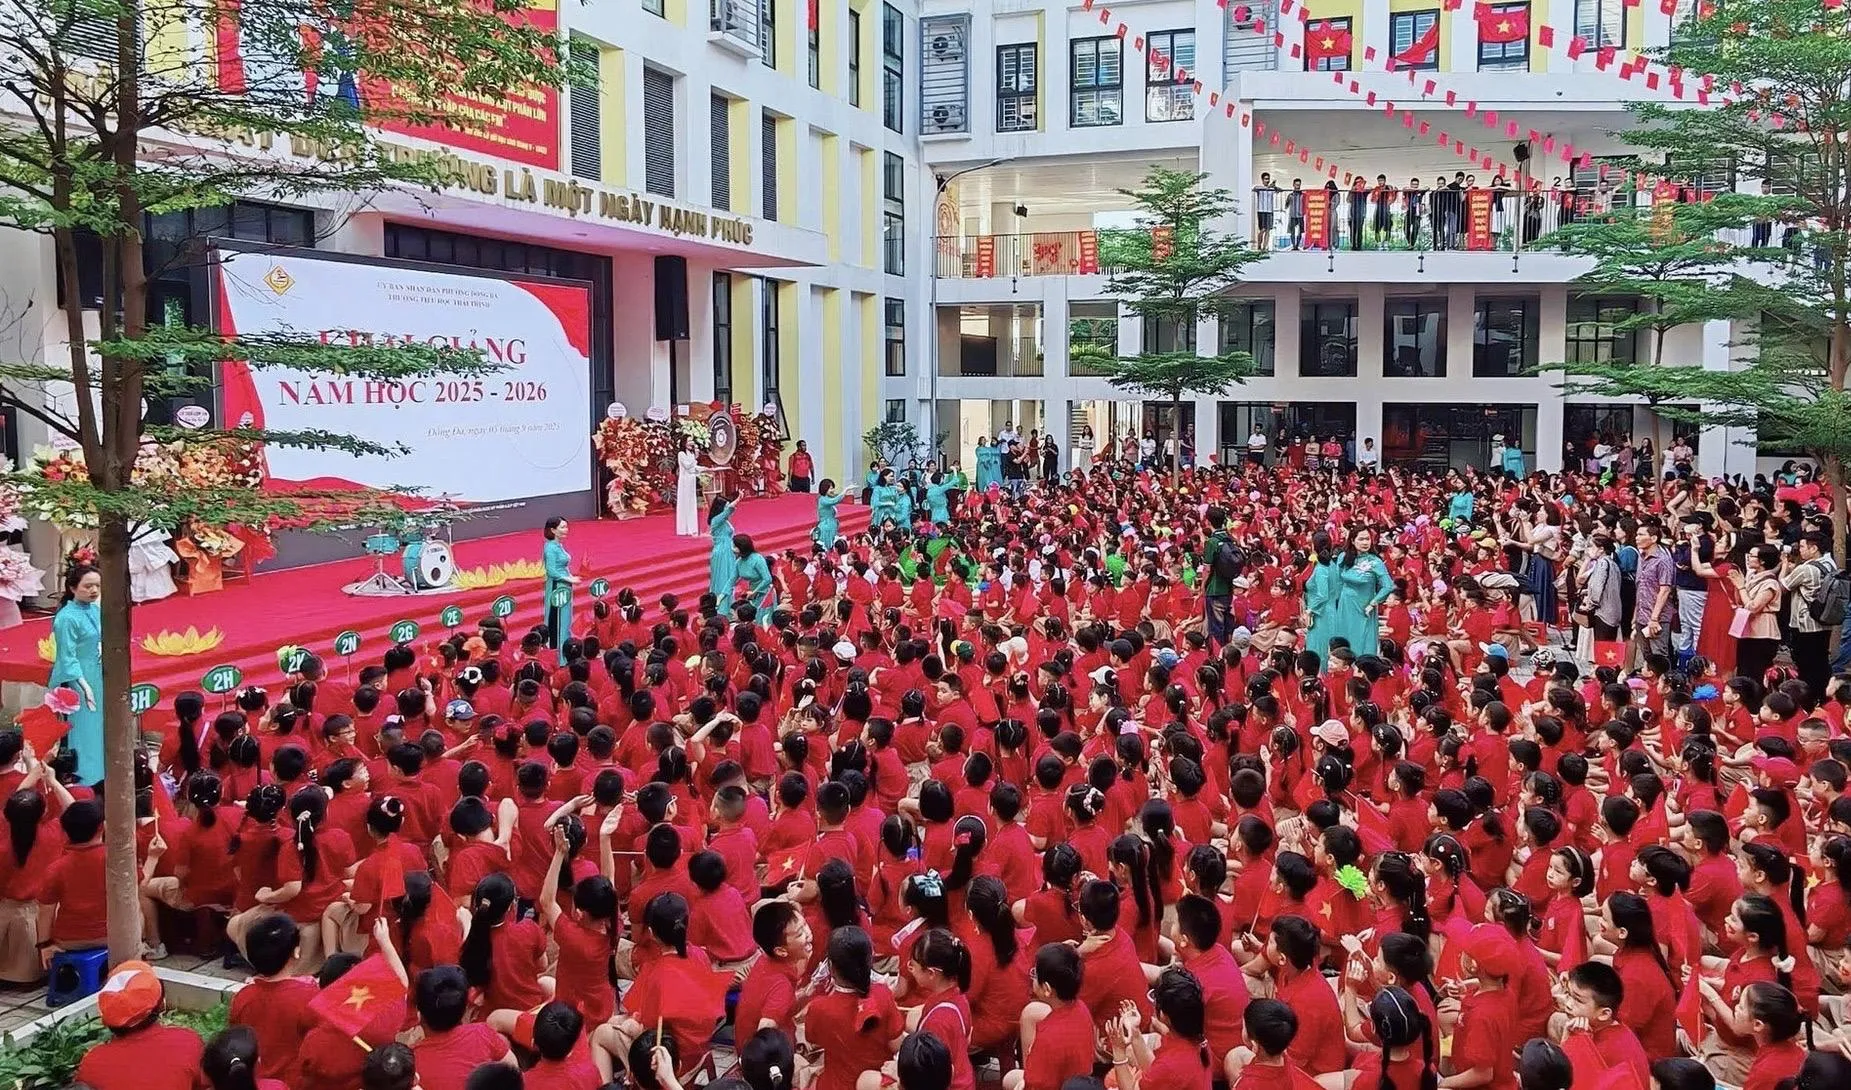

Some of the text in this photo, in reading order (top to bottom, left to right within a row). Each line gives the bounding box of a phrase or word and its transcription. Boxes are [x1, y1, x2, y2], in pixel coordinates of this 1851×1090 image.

[504, 167, 538, 203] LÀ
[544, 179, 594, 217] MỘT
[600, 191, 654, 227] NGÀY
[659, 205, 708, 237] HẠNH
[711, 216, 754, 246] PHÚC
[279, 374, 354, 406] NĂM
[365, 380, 427, 409] HỌC
[435, 381, 484, 403] 2025
[504, 380, 547, 402] 2026
[594, 583, 606, 596] 1K
[555, 591, 567, 606] 1N
[499, 601, 511, 616] 2D
[447, 610, 458, 626] 2E
[398, 625, 413, 642] 2G
[341, 638, 357, 655] 2N
[213, 671, 234, 692] 2H
